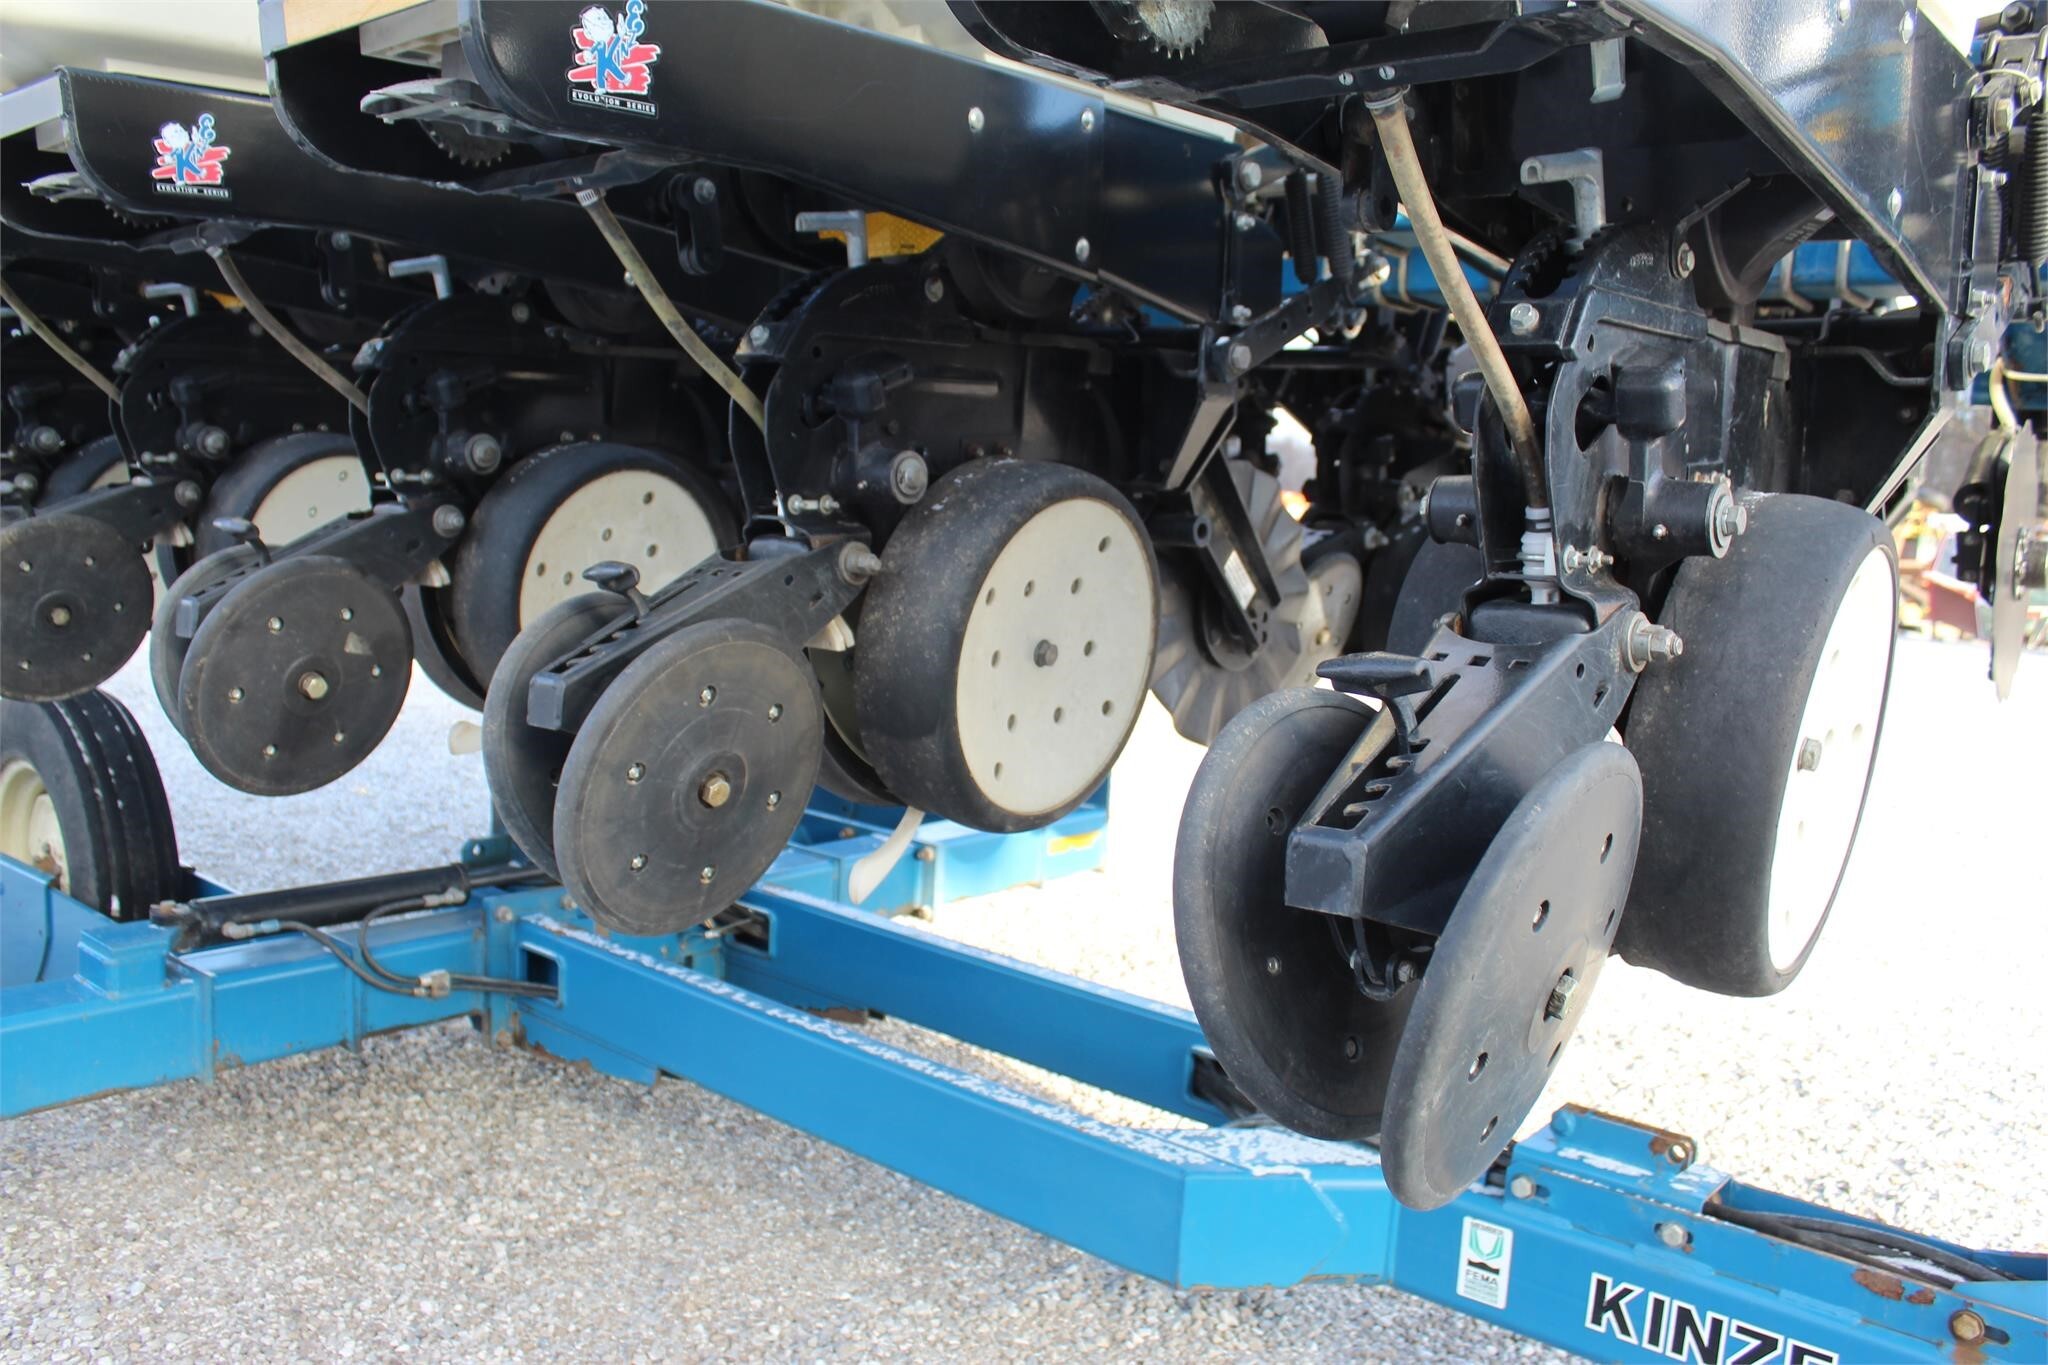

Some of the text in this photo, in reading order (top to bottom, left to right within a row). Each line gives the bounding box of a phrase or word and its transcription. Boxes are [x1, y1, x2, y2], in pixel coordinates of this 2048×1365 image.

[572, 91, 656, 115] EVOLUTION SERIES
[156, 184, 229, 198] EVOLUTION SERIES
[1465, 1269, 1498, 1286] FEMA
